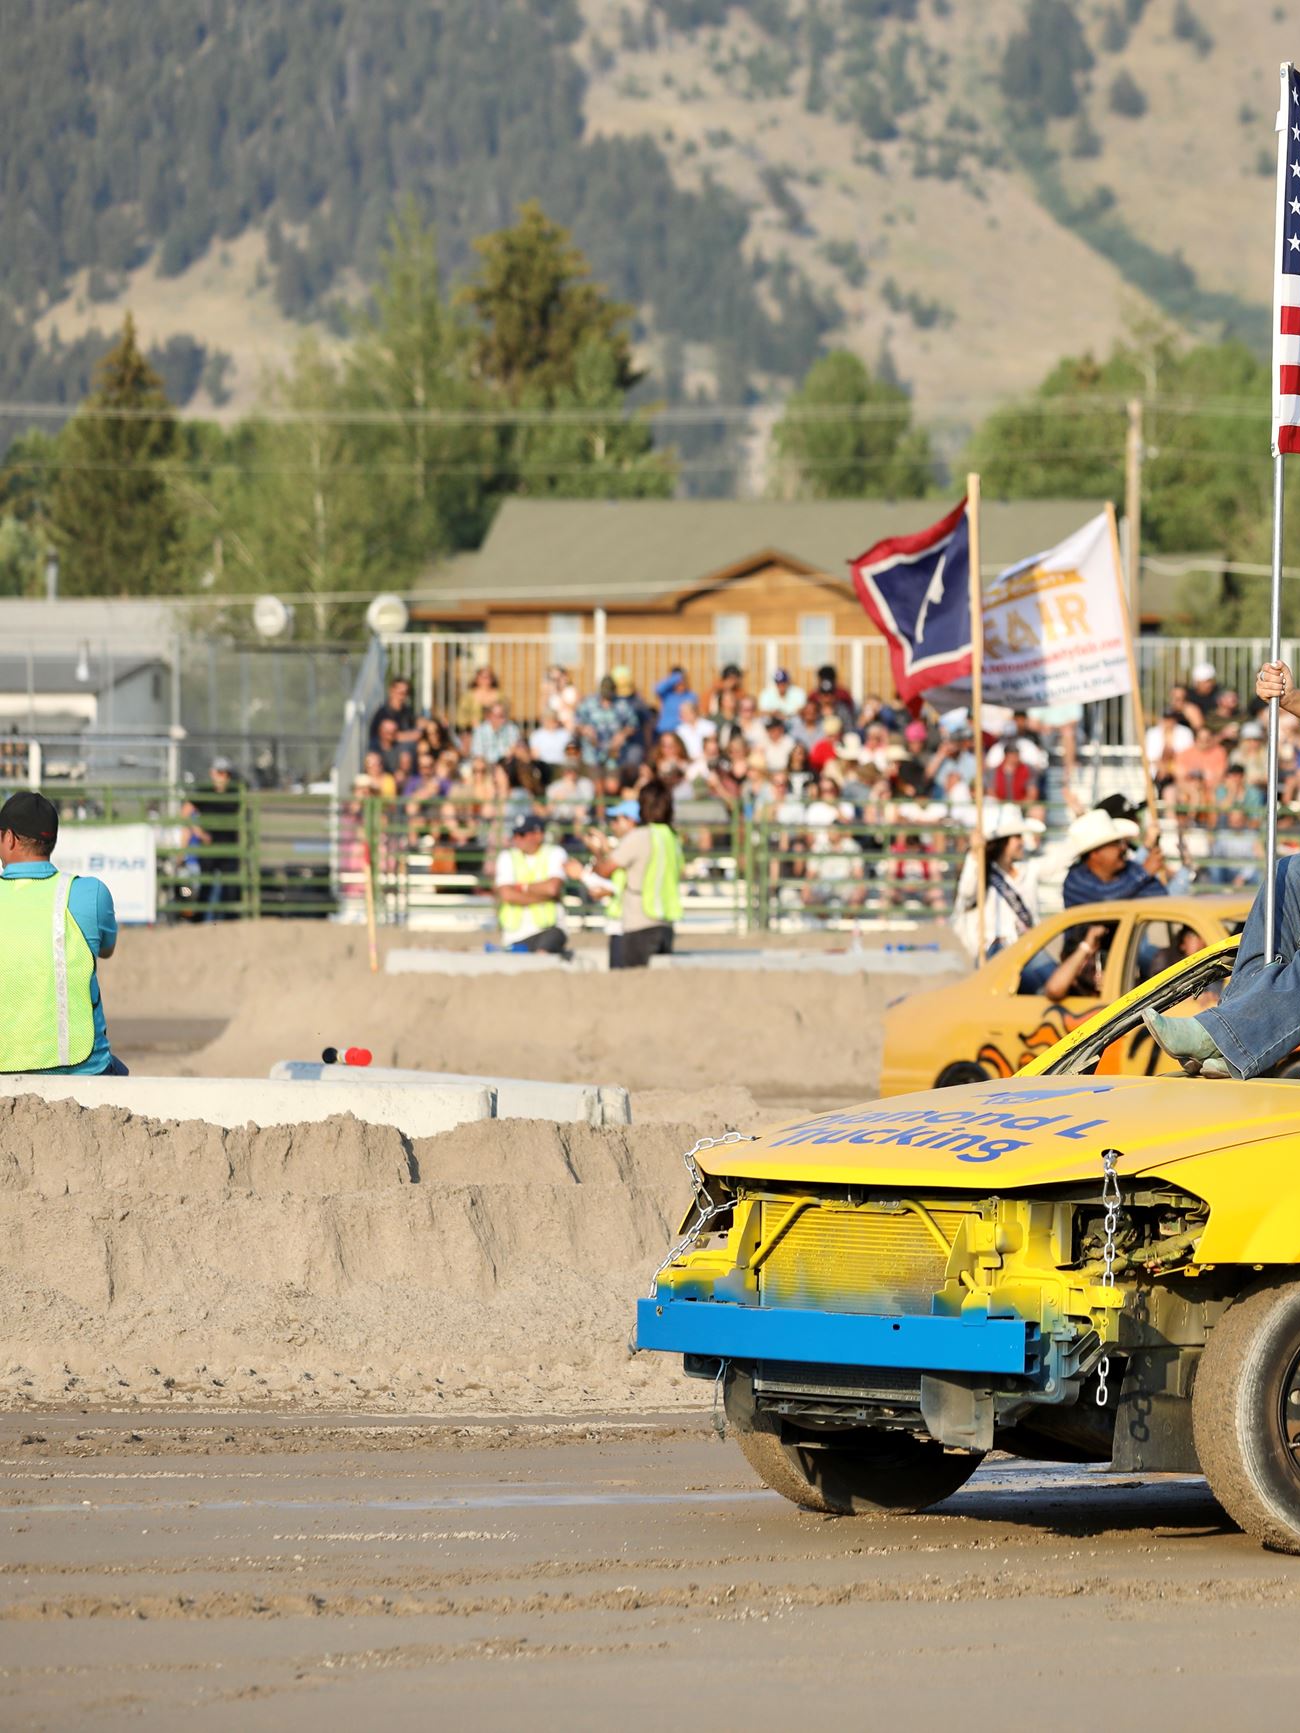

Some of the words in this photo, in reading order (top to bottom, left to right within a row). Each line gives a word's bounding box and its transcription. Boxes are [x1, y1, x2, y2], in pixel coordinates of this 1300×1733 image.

[770, 1108, 1074, 1134] Diamond
[1054, 1119, 1109, 1140] L
[767, 1126, 1034, 1163] Trucking
